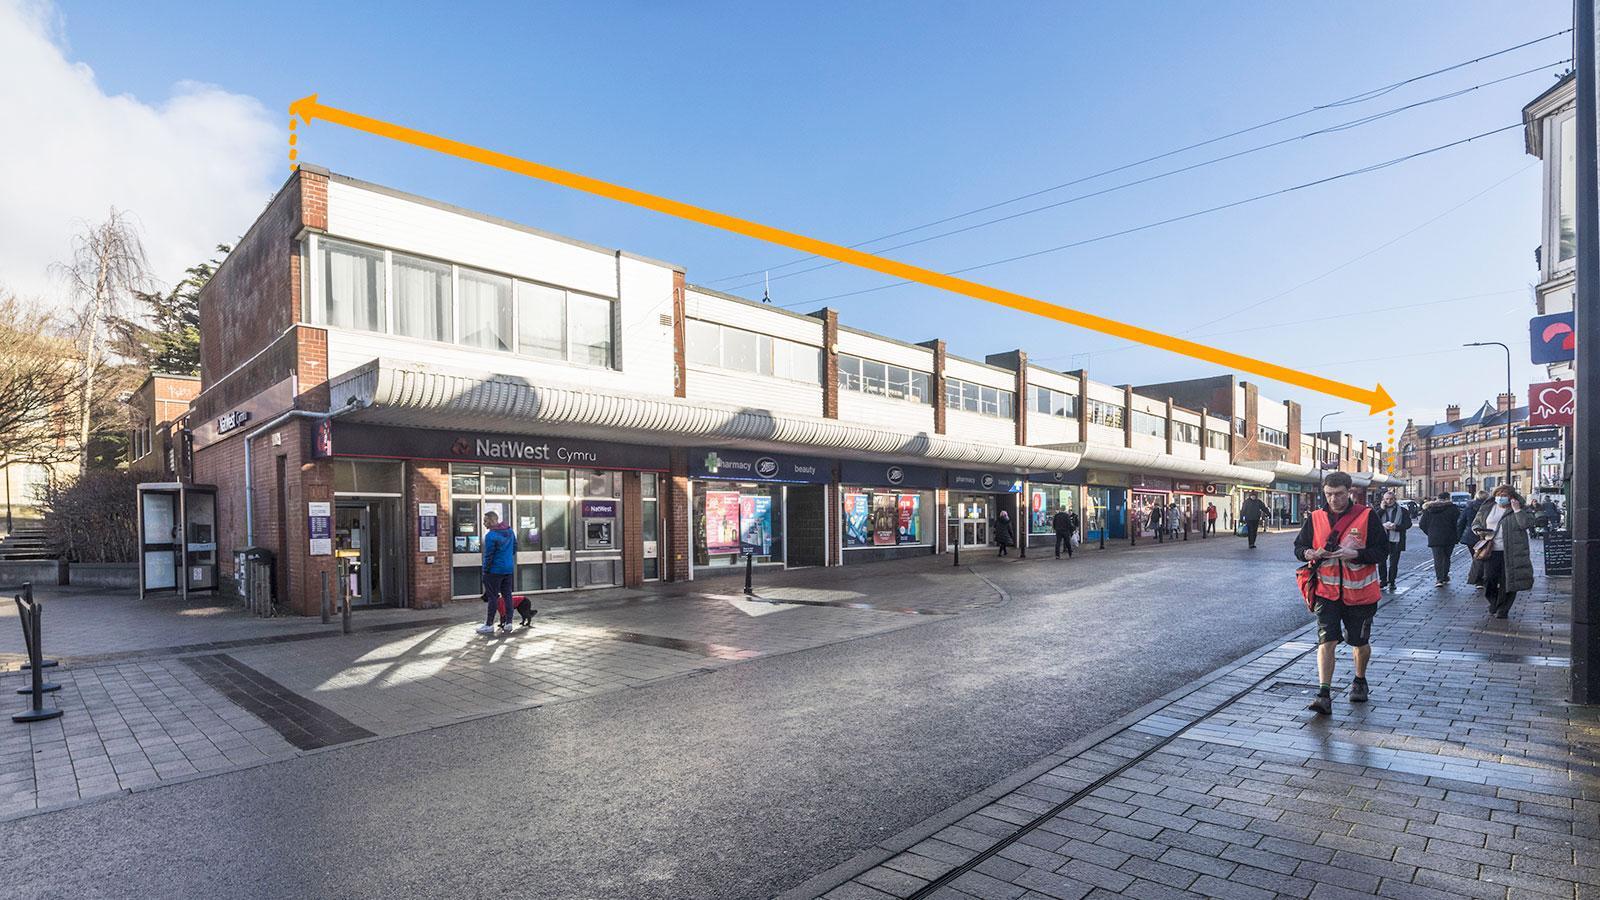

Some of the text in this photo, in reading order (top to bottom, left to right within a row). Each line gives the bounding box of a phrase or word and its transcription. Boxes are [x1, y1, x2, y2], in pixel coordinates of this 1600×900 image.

[217, 412, 236, 433] NatWest
[476, 438, 597, 463] NatWest Cymru
[718, 460, 752, 472] harmacy
[794, 465, 816, 475] beauty
